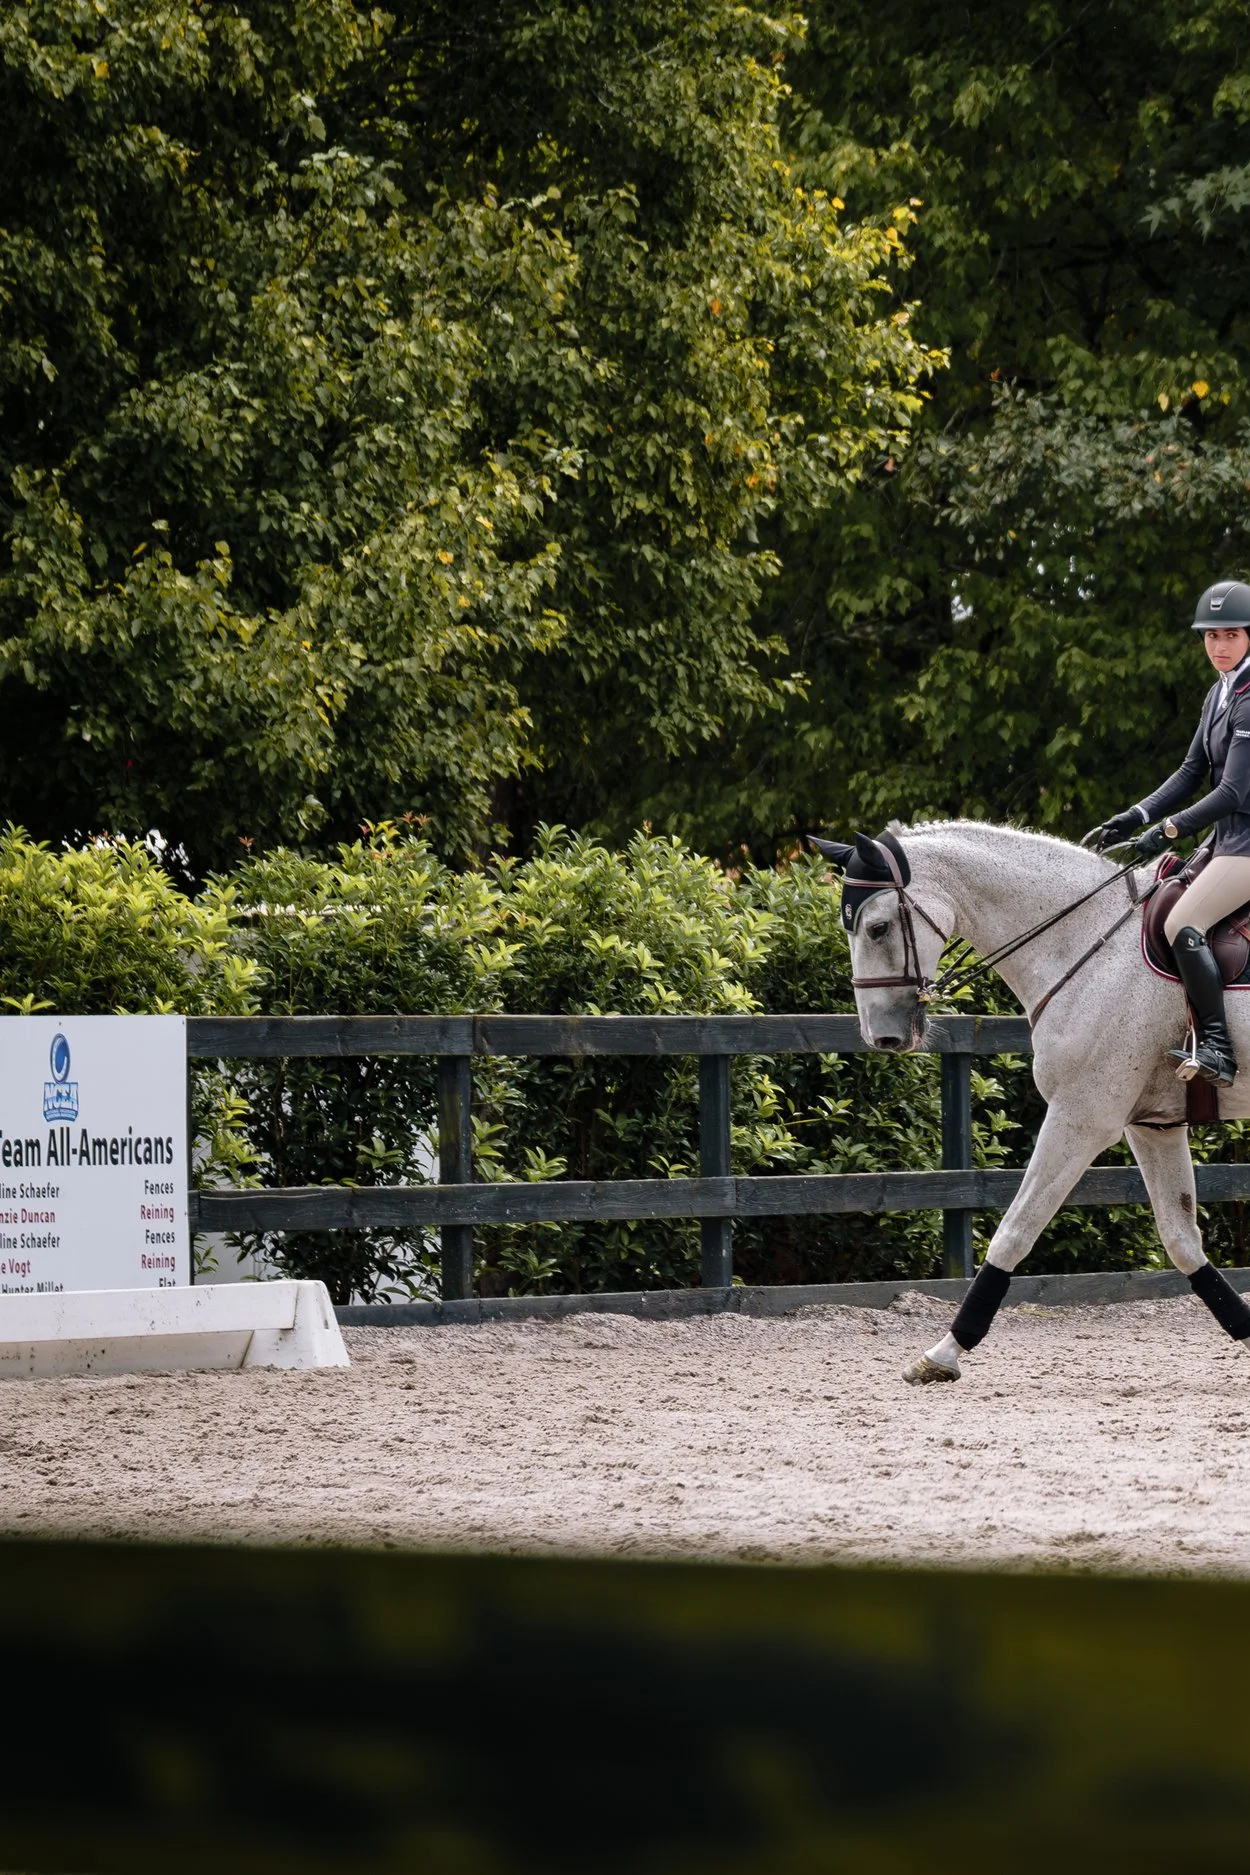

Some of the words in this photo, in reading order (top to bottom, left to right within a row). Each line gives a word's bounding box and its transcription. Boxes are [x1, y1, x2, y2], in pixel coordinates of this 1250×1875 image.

[46, 1126, 173, 1166] All-Americans
[20, 1181, 60, 1199] Schaefer
[144, 1179, 174, 1195] Fences
[21, 1208, 56, 1223] Duncan
[140, 1203, 174, 1223] Reining
[20, 1232, 61, 1249] Schaefer
[145, 1229, 175, 1244] Fences
[8, 1258, 31, 1278] Vogt
[141, 1252, 176, 1272] Reining
